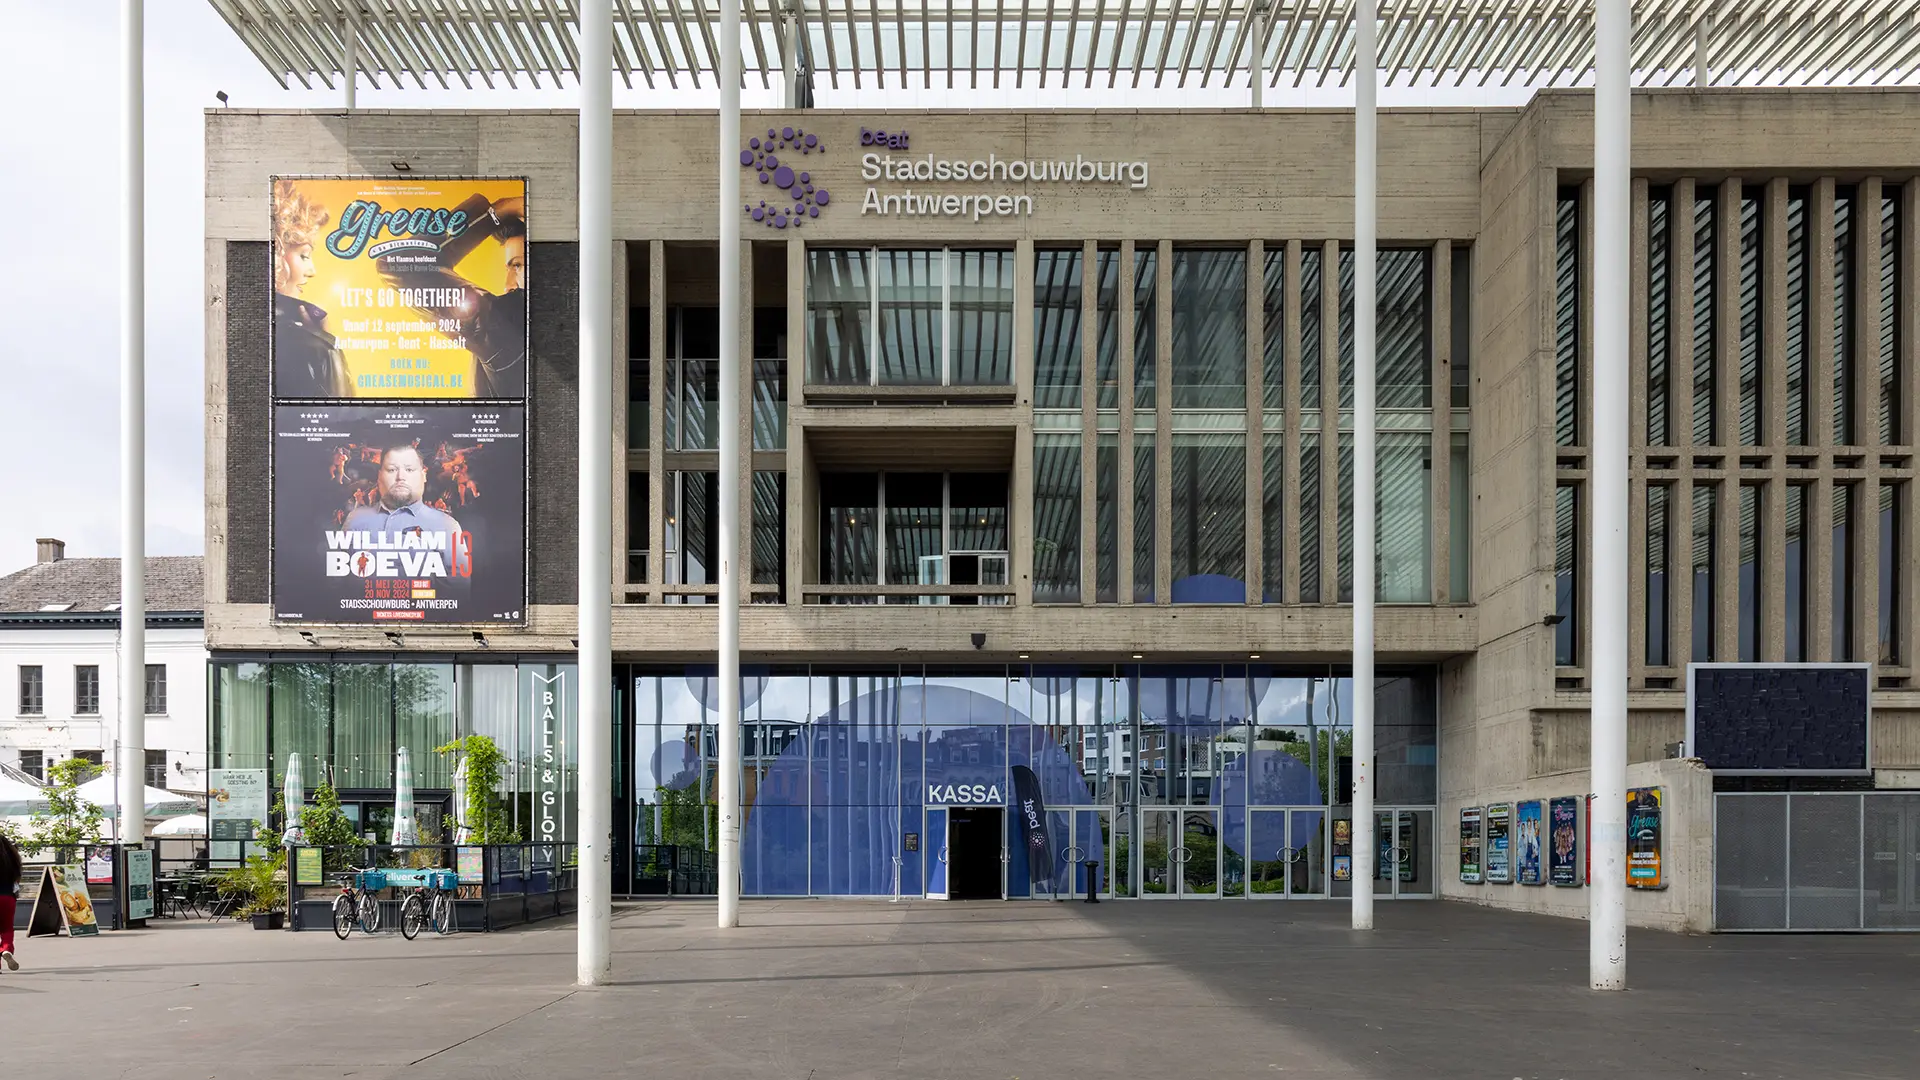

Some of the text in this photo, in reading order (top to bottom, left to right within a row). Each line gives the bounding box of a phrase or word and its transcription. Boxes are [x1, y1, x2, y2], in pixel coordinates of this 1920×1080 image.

[860, 127, 909, 150] beat
[861, 153, 1149, 189] Stadsschouwburg
[861, 187, 1033, 222] Antwerpen
[326, 199, 469, 260] grease
[341, 287, 466, 308] LET'S GO TOGETHER!
[342, 319, 461, 335] Vanaf 12 september 2024
[334, 336, 389, 352] Antwerpen
[429, 336, 466, 349] Hasselt
[390, 358, 412, 369] BOEK
[357, 374, 463, 388] GREASEMUSICAL.BE
[325, 530, 473, 577] WILLIAM 13
[326, 551, 448, 578] BOEVA
[364, 579, 372, 589] 31
[375, 579, 391, 589] MEI
[392, 579, 410, 589] 2024
[364, 589, 374, 599] 20
[375, 589, 391, 599] NOV
[392, 589, 410, 599] 2024
[340, 599, 458, 609] STADSSCHOUWBURG ANTWERPEN
[541, 691, 555, 763] BALLS
[541, 769, 555, 784] &
[928, 784, 1002, 803] KASSA
